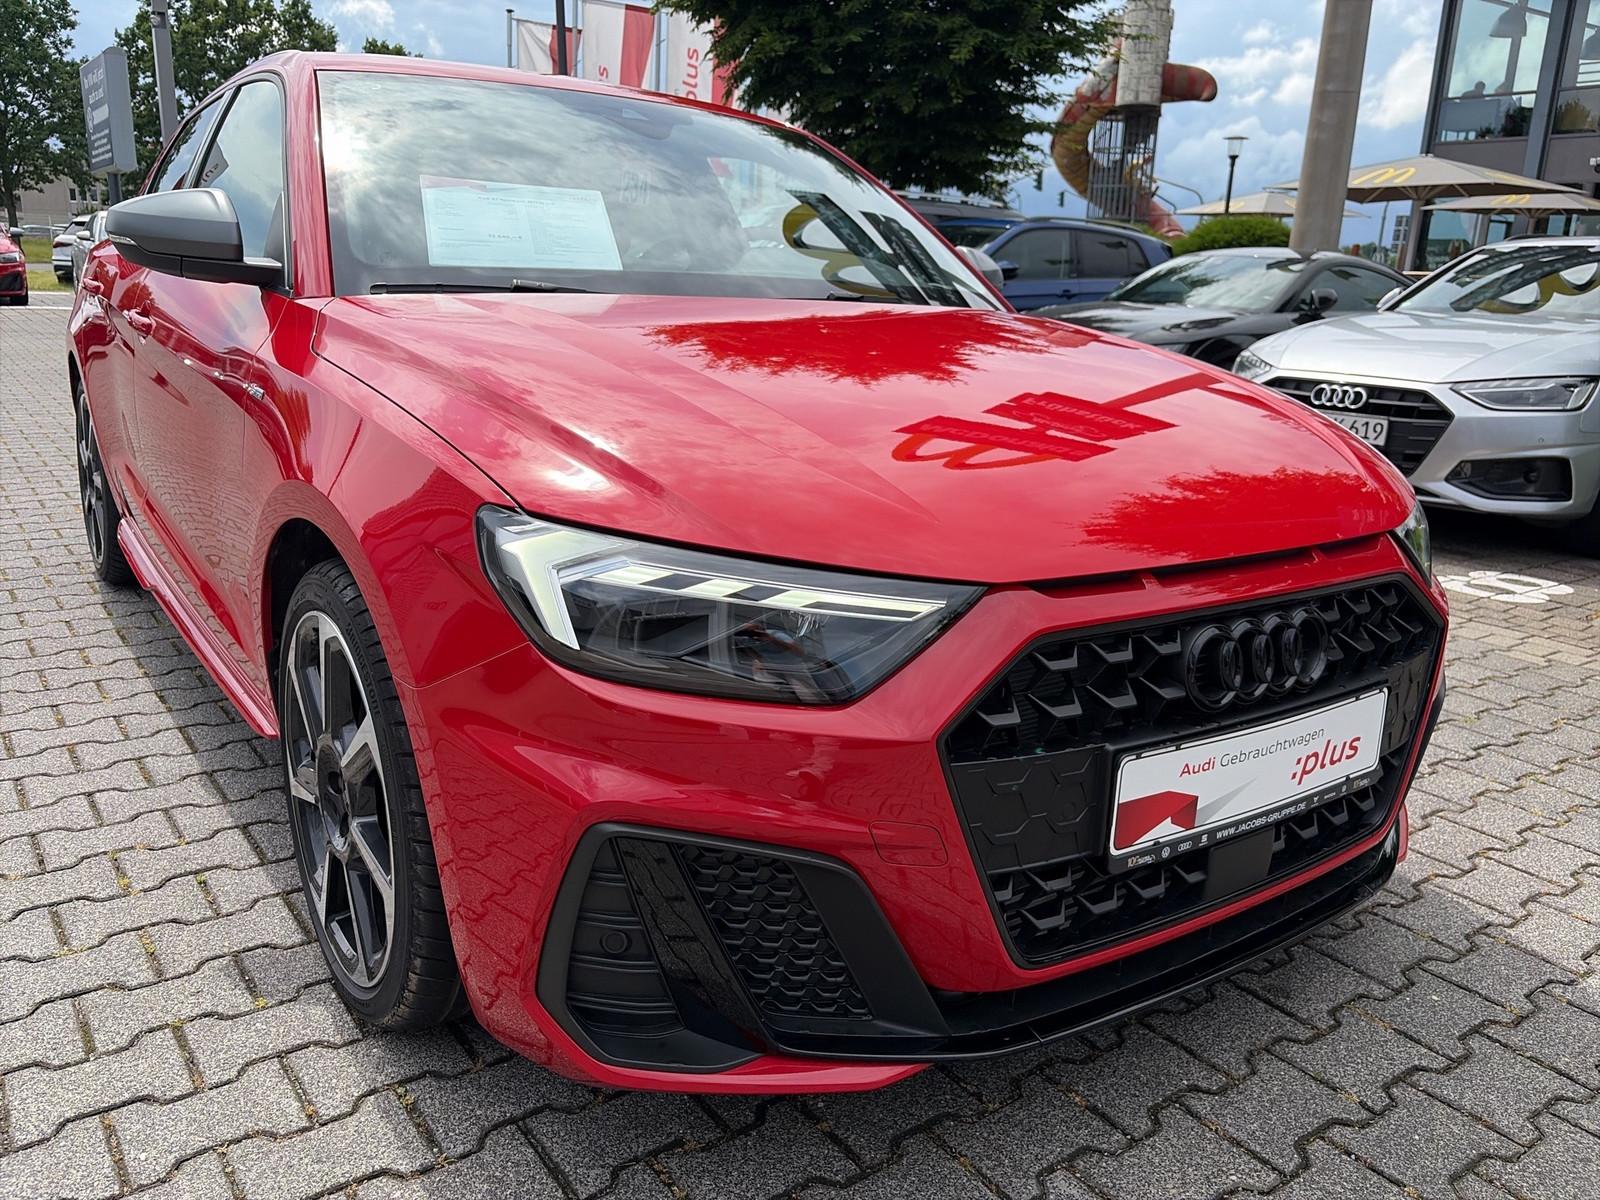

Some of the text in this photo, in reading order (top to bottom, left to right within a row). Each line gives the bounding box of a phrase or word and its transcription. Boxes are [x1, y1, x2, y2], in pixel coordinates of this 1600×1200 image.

[1349, 420, 1384, 441] 619
[1179, 728, 1325, 778] Audi Gebrauchtwagen
[1290, 736, 1361, 786] :plus
[1216, 801, 1307, 840] WWW.JACOBS-GRUPPE.DE
